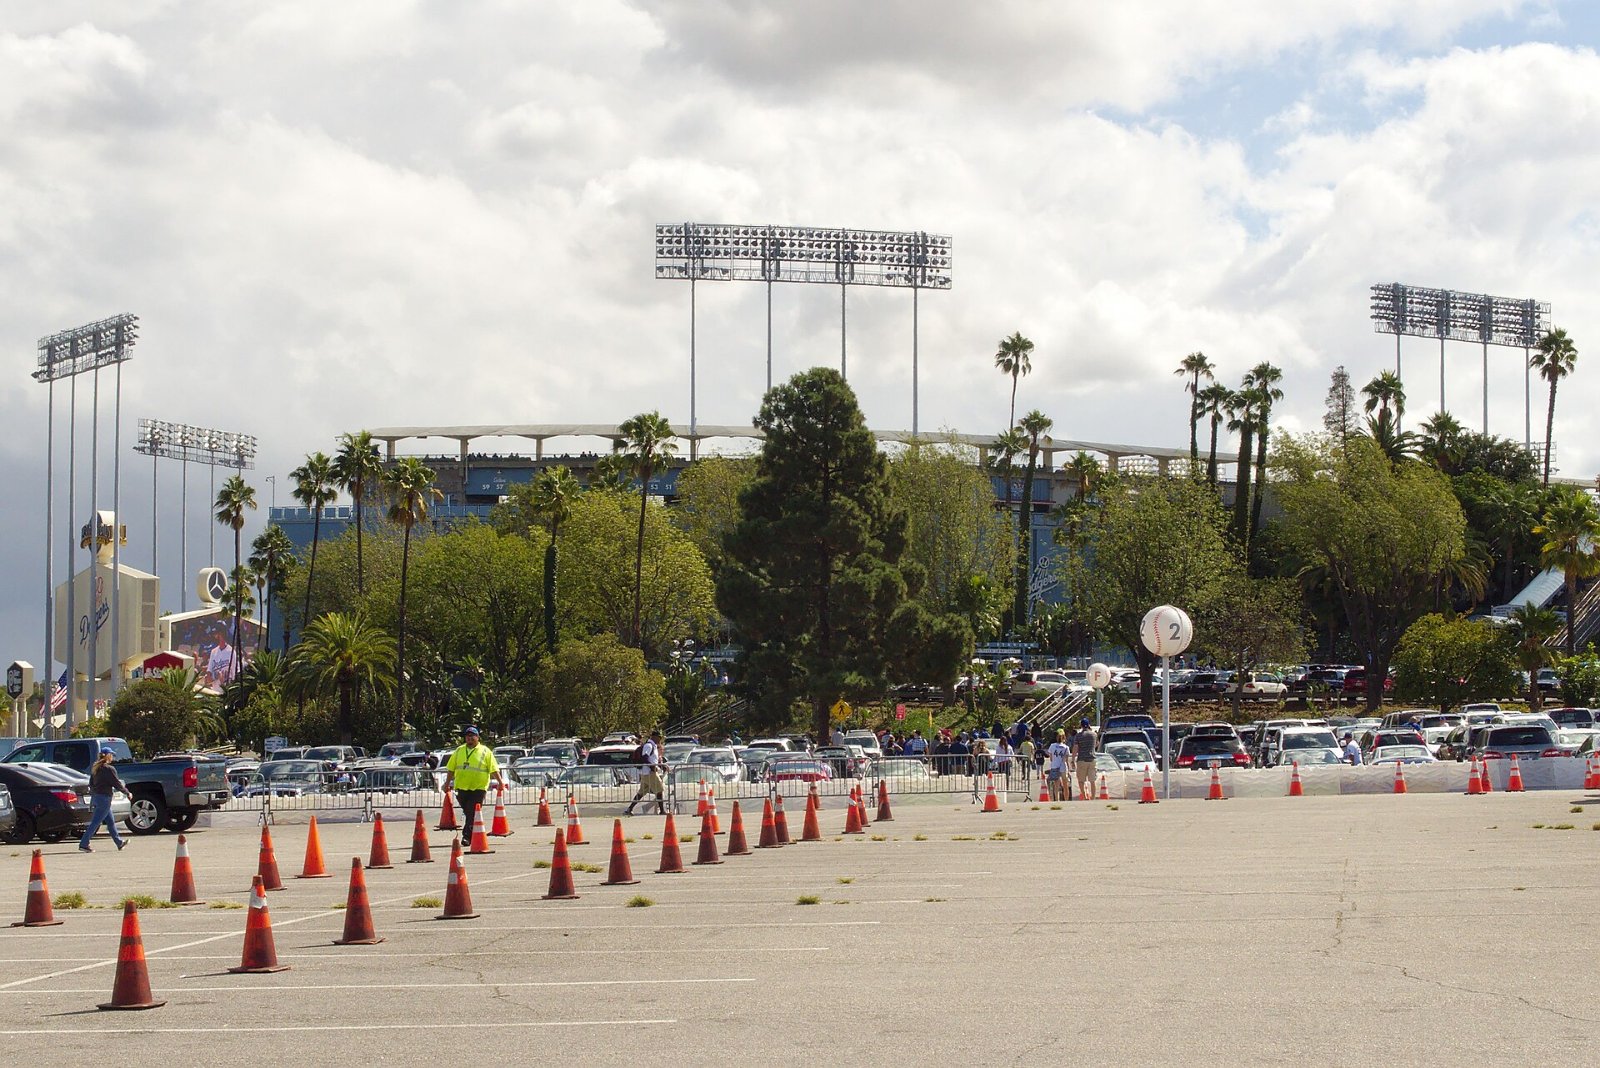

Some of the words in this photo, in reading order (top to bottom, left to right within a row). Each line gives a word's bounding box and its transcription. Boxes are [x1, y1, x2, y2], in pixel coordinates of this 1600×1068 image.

[1169, 622, 1181, 640] 2
[1094, 671, 1101, 681] F
[1053, 749, 1064, 758] 44
